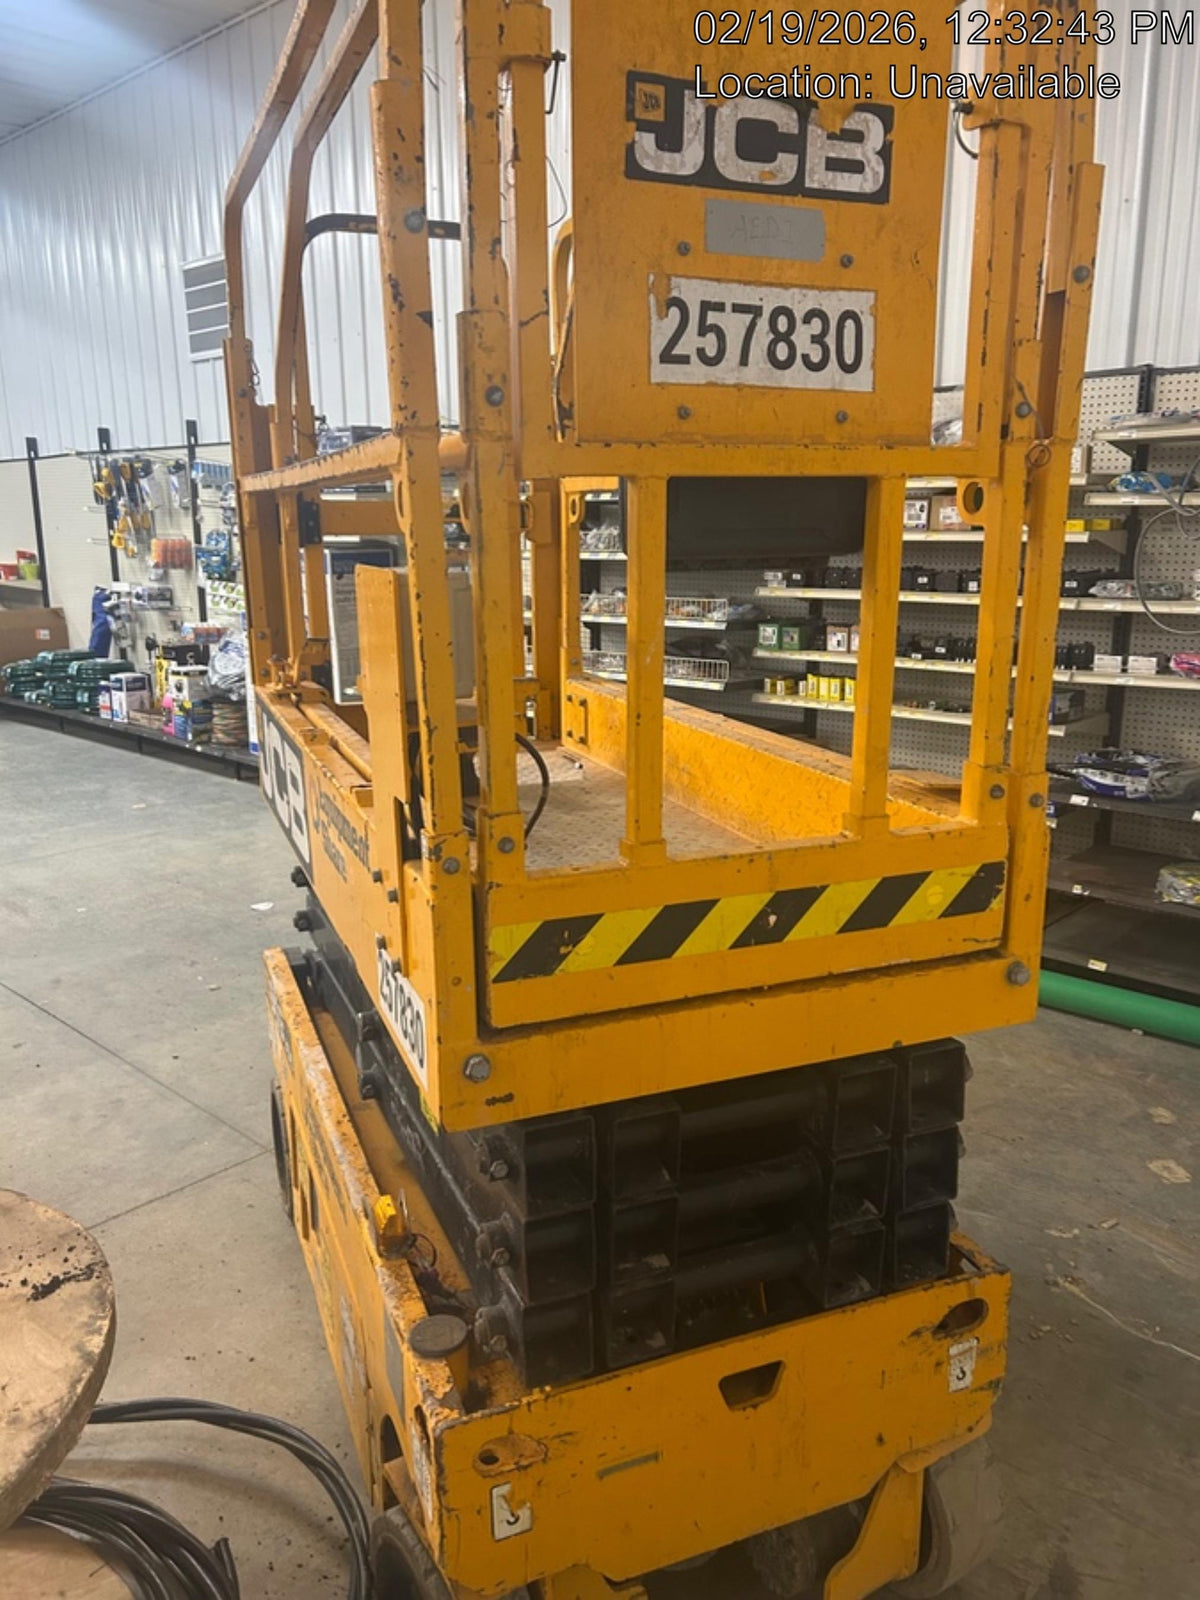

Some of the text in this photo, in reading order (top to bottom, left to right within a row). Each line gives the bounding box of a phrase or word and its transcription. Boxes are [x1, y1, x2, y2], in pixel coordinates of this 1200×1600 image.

[634, 88, 885, 194] JCB
[659, 296, 863, 374] 257830
[260, 711, 311, 864] JCB
